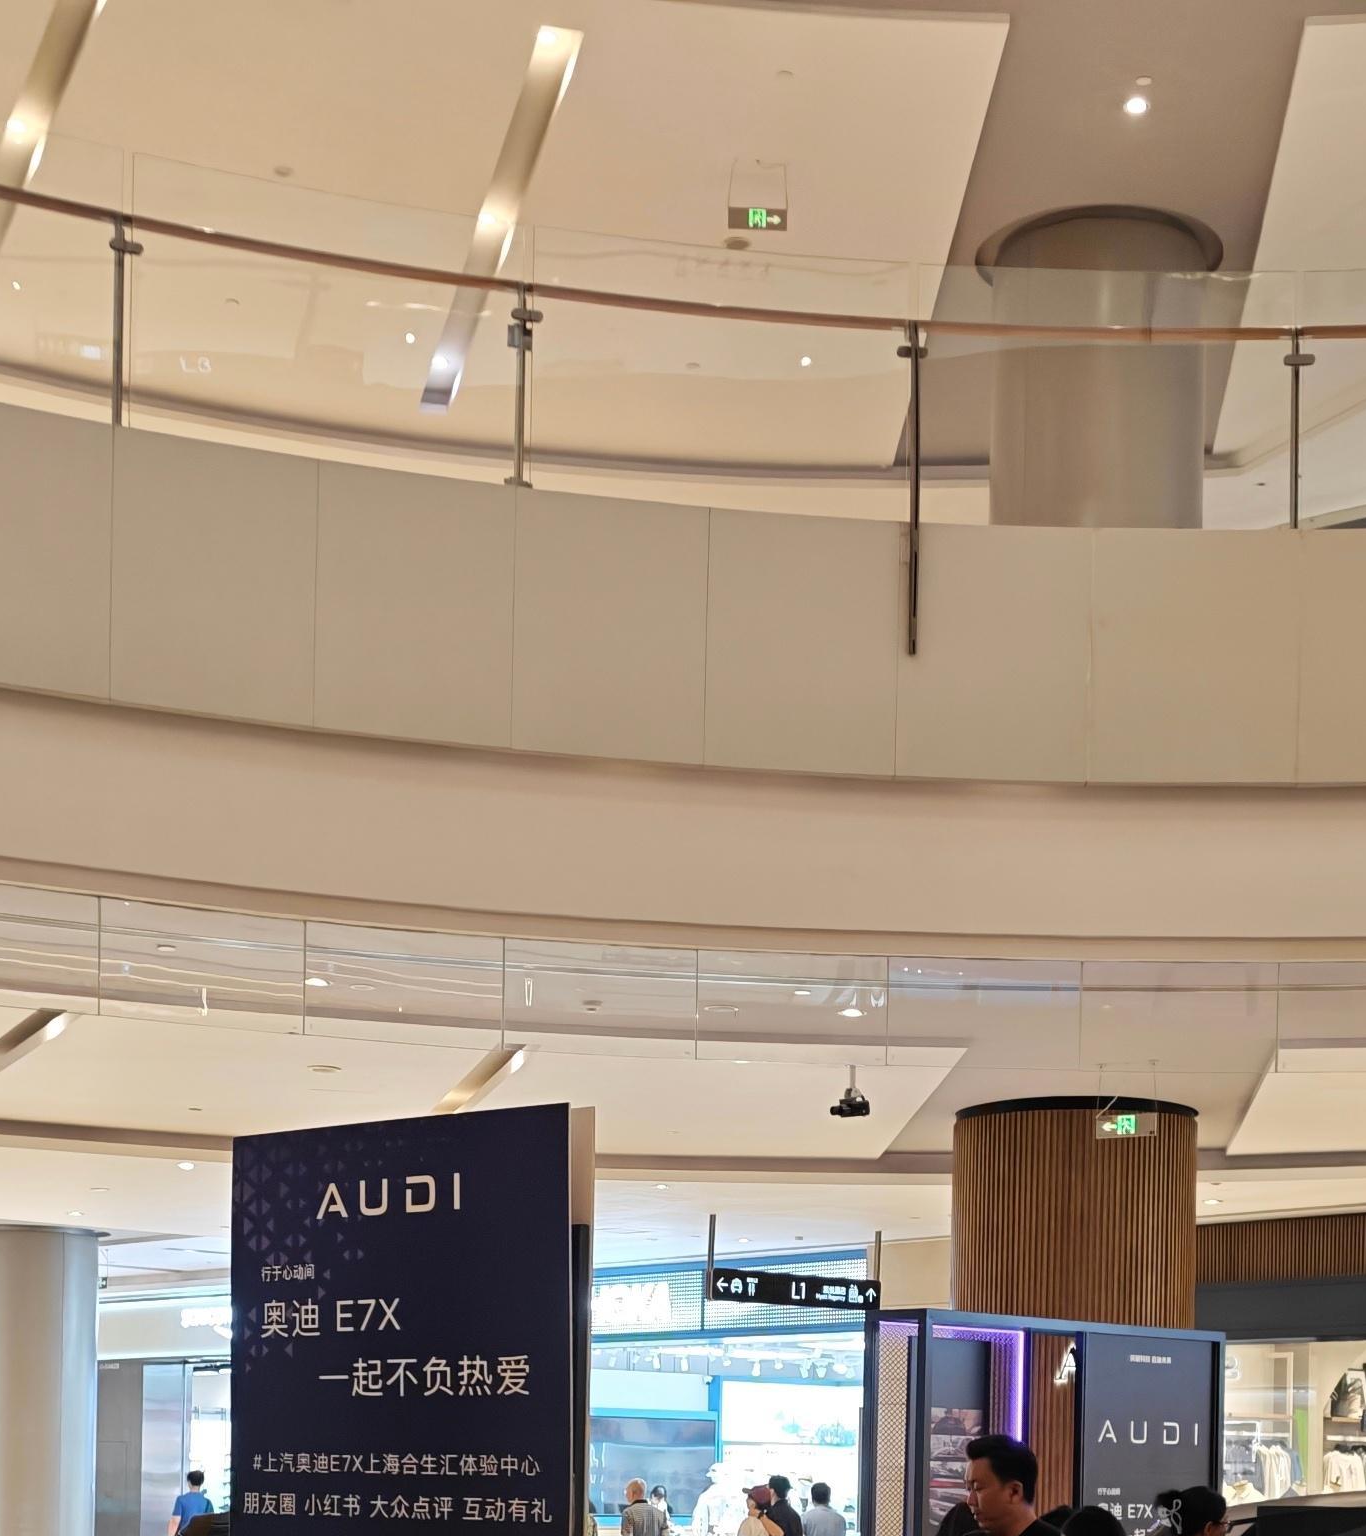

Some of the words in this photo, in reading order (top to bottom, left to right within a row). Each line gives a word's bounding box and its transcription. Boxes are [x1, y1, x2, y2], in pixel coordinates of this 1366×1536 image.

[316, 1172, 461, 1220] AUDI
[260, 1263, 316, 1282] 行于心动间
[791, 1281, 806, 1300] L1
[260, 1299, 321, 1338] 奥迪
[335, 1298, 401, 1332] E7X
[318, 1354, 531, 1397] 一起不负热爱
[1097, 1419, 1199, 1446] AUDI
[252, 1453, 541, 1477] #上汽奥迪E7X上海合生汇体验中心
[243, 1492, 297, 1516] 朋友圈
[304, 1493, 361, 1517] 小红书
[369, 1495, 454, 1521] 大众点评
[462, 1497, 553, 1523] 互动有礼
[1127, 1503, 1153, 1519] E7X
